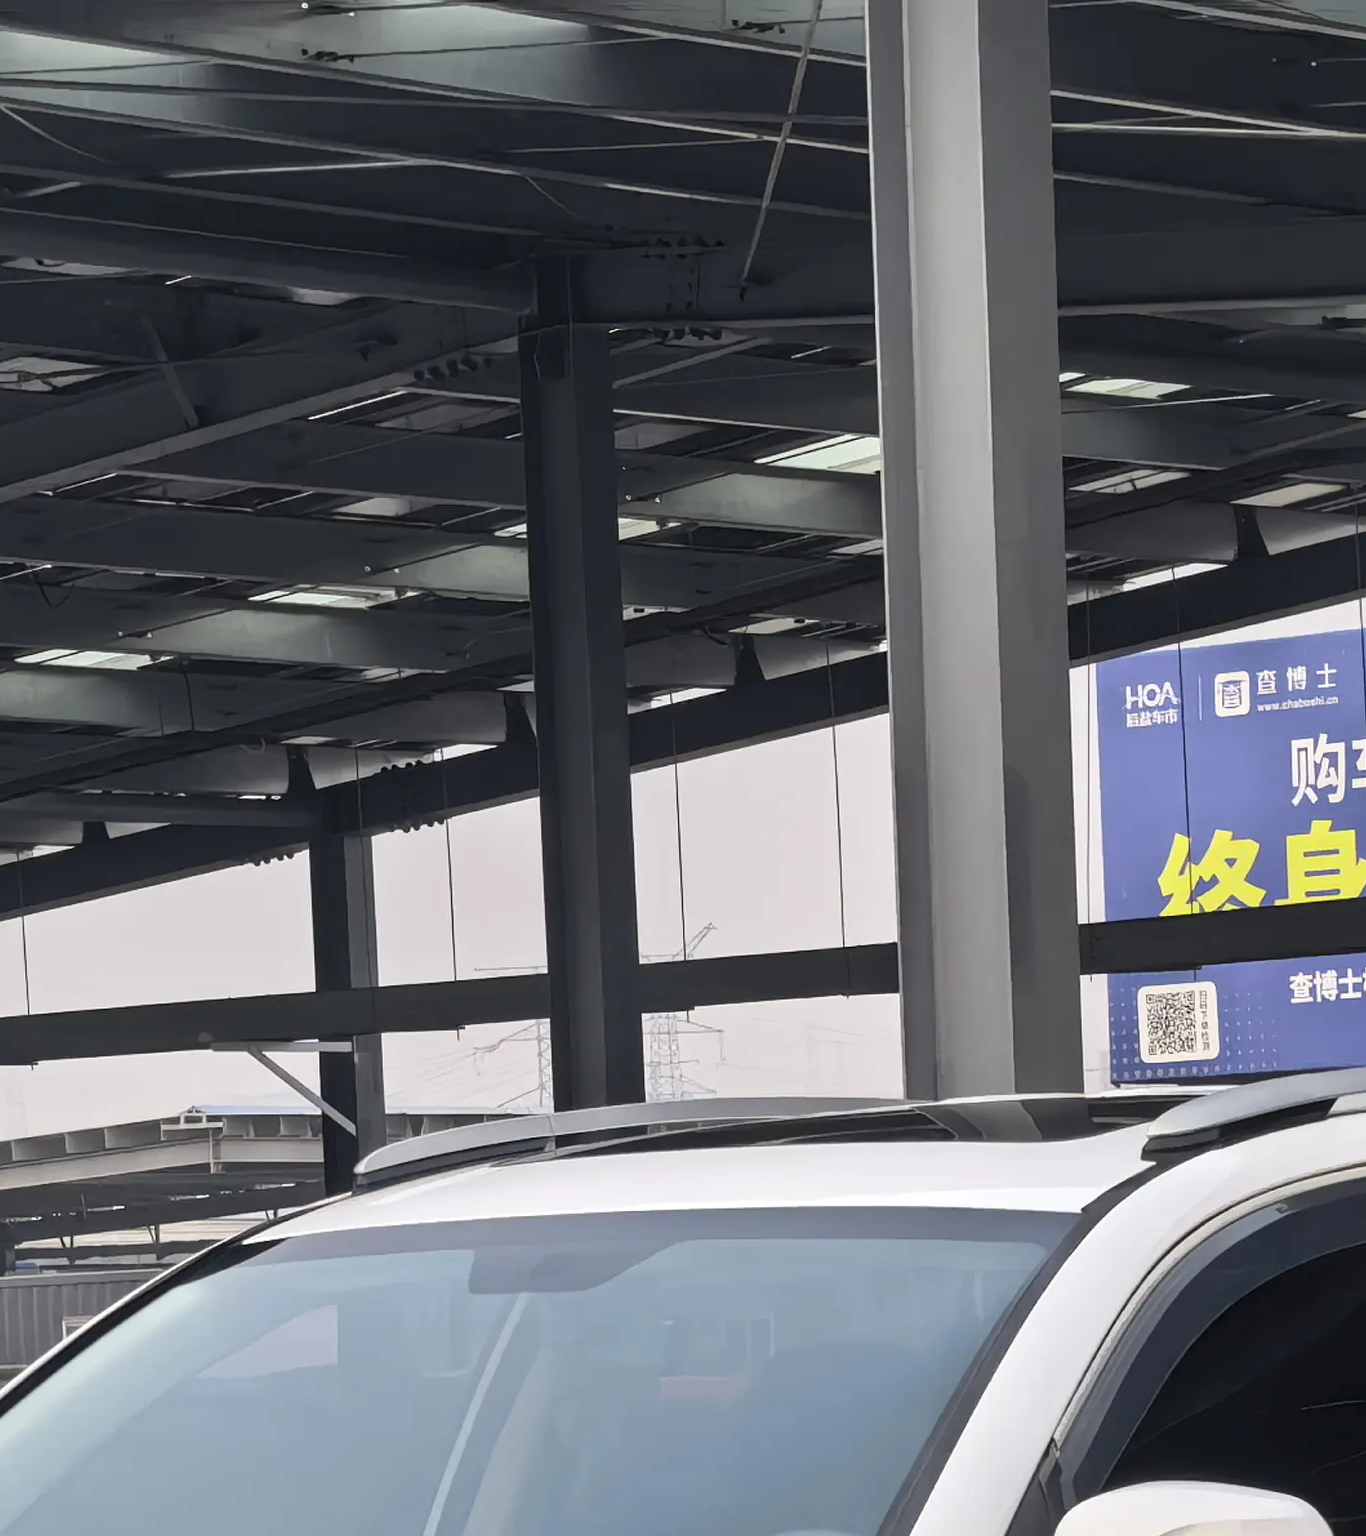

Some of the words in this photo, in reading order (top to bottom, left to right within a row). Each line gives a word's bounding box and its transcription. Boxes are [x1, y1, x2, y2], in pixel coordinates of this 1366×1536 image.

[1255, 662, 1338, 695] 查博士
[1125, 681, 1180, 710] HOA
[1256, 696, 1339, 712] www.chaboshi.cn
[1126, 708, 1179, 728] 后盐车市
